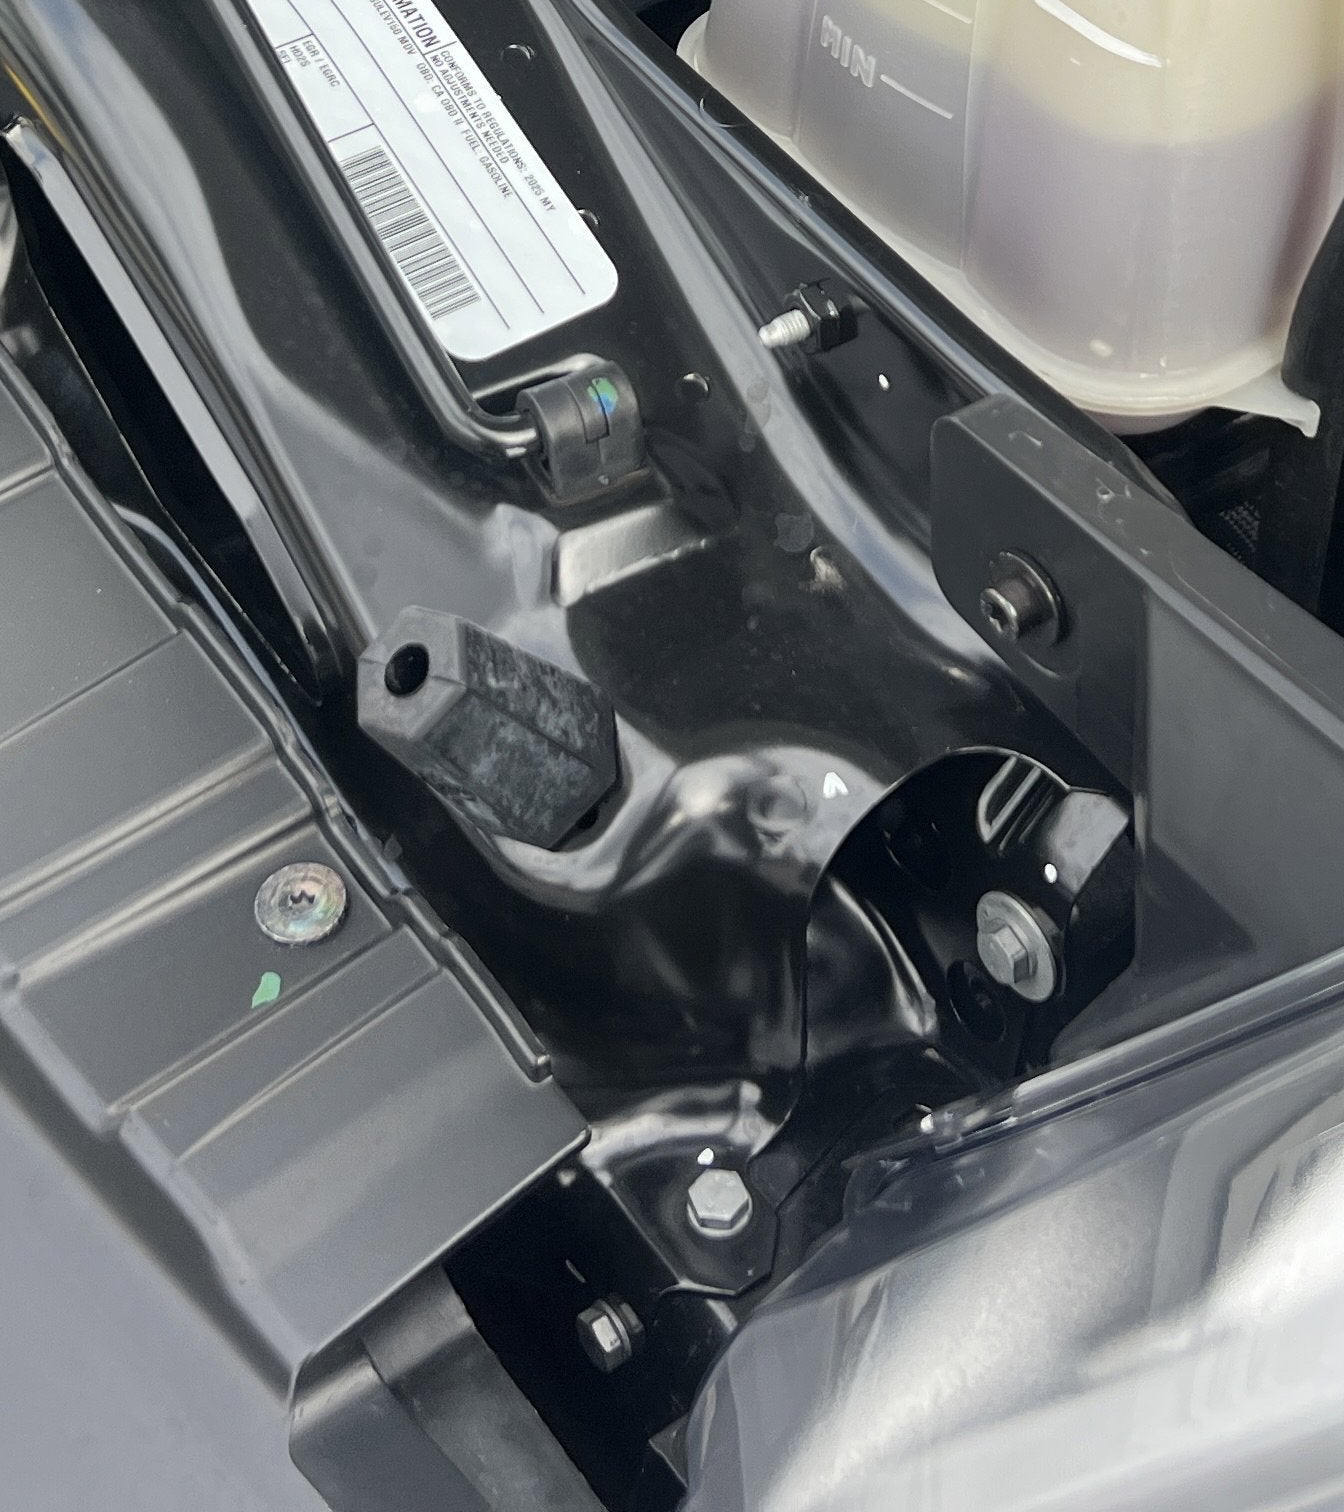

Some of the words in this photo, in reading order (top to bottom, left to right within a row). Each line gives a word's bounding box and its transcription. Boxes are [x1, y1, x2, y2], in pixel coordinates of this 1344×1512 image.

[301, 39, 319, 57] EGR
[819, 14, 876, 88] MIN
[429, 53, 445, 68] NO
[439, 68, 486, 130] ADJUSTMENTS
[480, 129, 510, 164] NEEDED
[430, 83, 446, 98] CA
[439, 97, 460, 118] OBD
[477, 154, 514, 199] GASOLINE
[438, 49, 478, 98] CONFORMS
[471, 97, 488, 111] TO
[480, 109, 529, 173] REGULATIONS:
[523, 173, 546, 197] 2025
[538, 196, 557, 213] MY
